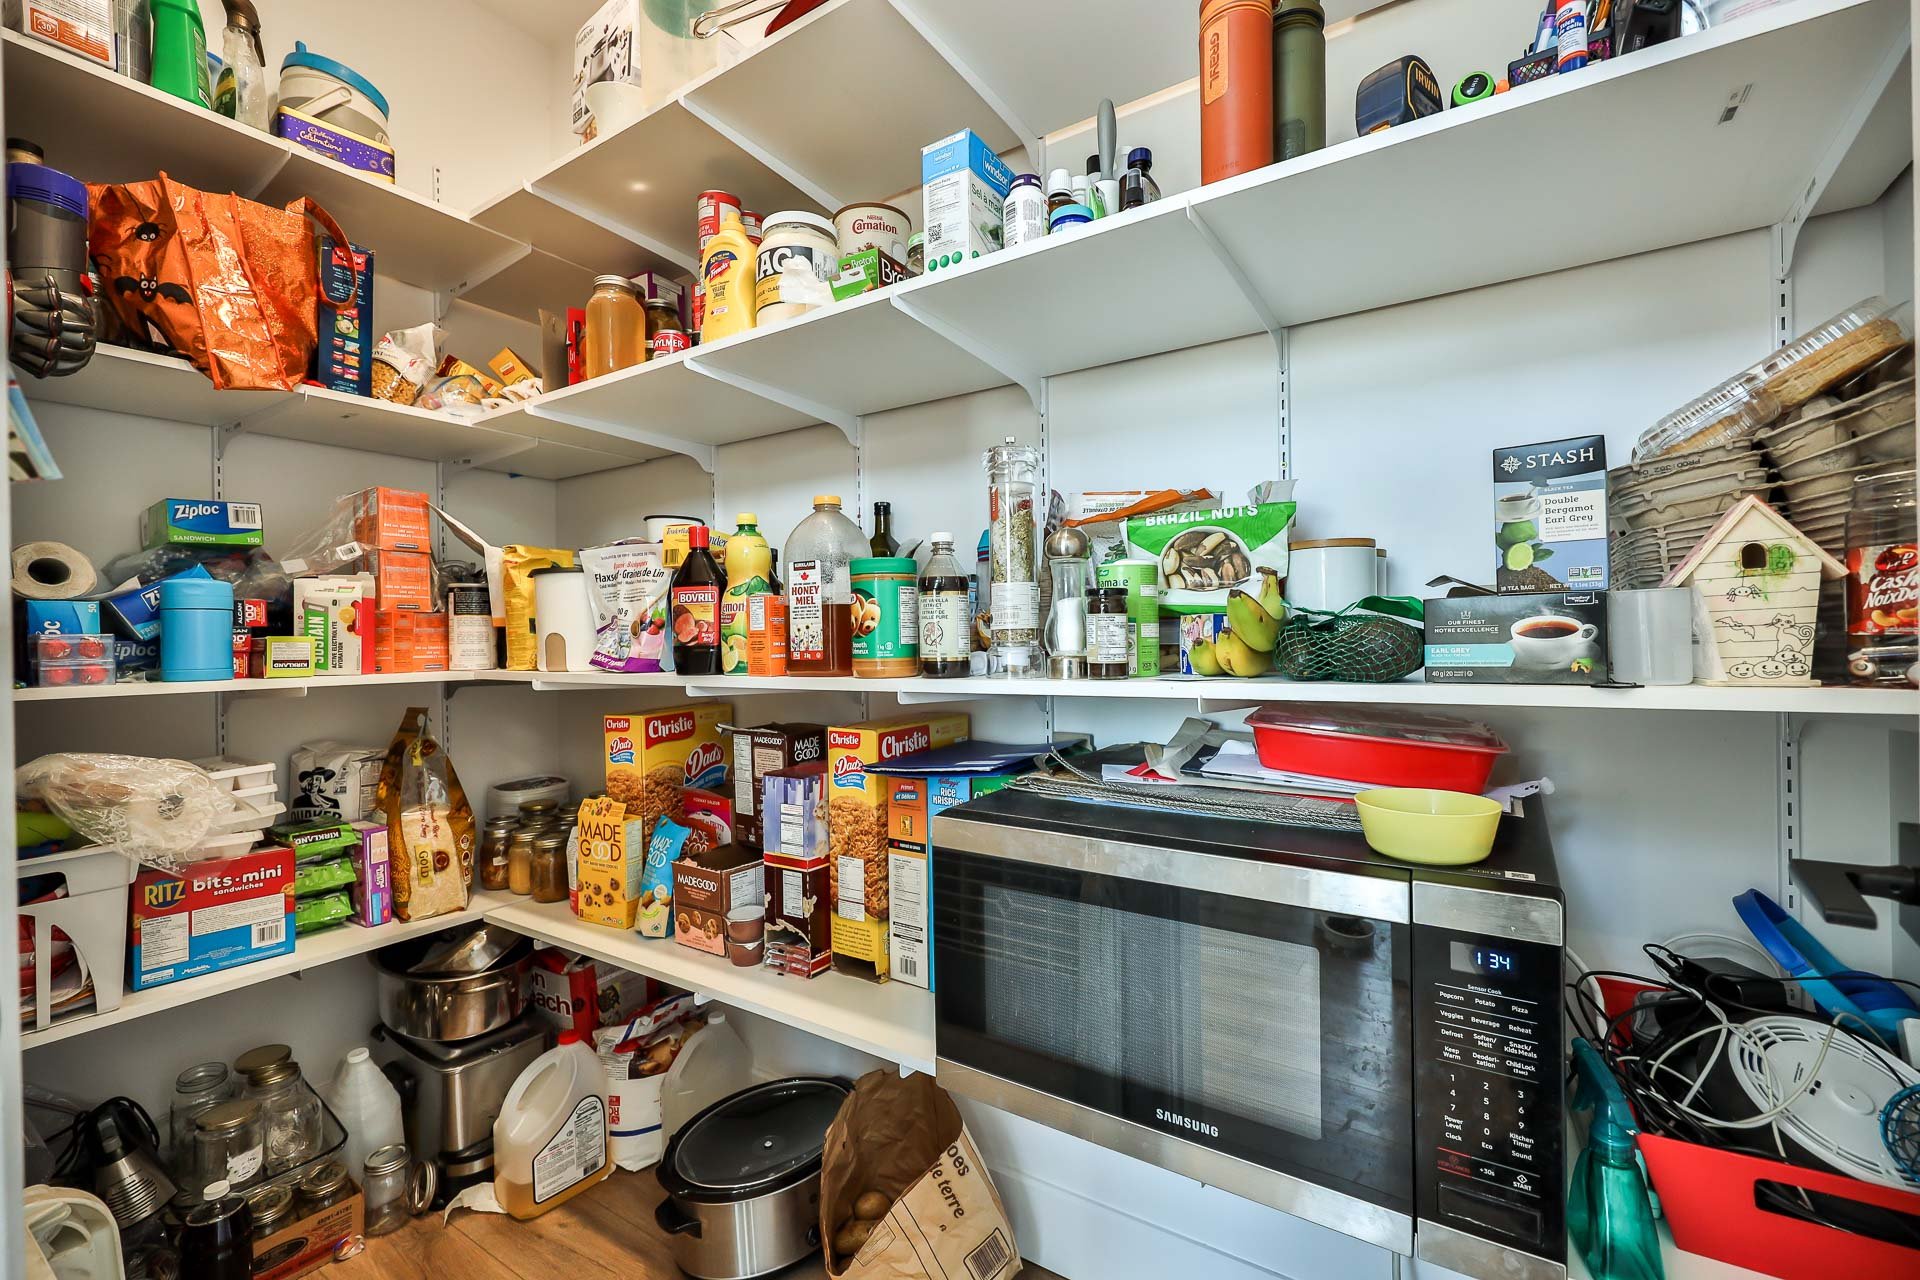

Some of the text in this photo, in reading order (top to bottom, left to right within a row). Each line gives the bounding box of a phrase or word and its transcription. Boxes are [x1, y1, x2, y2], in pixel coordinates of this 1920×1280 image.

[1209, 32, 1220, 90] GRAYL
[1415, 68, 1440, 100] IRWIN
[984, 160, 1008, 186] windsor
[852, 219, 898, 234] Carnation
[852, 256, 876, 268] Breton
[1526, 448, 1594, 468] STASH
[1544, 496, 1579, 506] Double
[174, 504, 220, 520] Ziploc
[1545, 504, 1594, 516] Bergamot
[1145, 505, 1258, 527] BRAZIL NUTS
[1545, 514, 1594, 524] Earl Grey
[652, 568, 664, 578] Lin
[792, 586, 820, 596] HONEY
[680, 592, 714, 603] BOVRIL
[796, 596, 816, 605] MIEL
[88, 604, 96, 613] 50
[606, 720, 629, 729] Christie
[648, 717, 693, 738] Christie
[794, 736, 820, 751] MADE
[830, 733, 859, 745] Christie
[881, 729, 928, 758] Christie
[612, 739, 631, 752] Dad's
[794, 747, 820, 761] GOOD
[688, 746, 721, 777] Dad's
[580, 820, 621, 843] MADE
[294, 831, 339, 845] KIRKLAND
[651, 835, 673, 849] MADE
[580, 839, 621, 862] GOOD
[418, 850, 430, 878] GOLD
[193, 864, 282, 892] bits mini
[677, 873, 717, 892] MADEGOOD
[144, 880, 186, 906] RITZ
[213, 882, 264, 896] sandwiches
[1467, 984, 1502, 996] Sensor Cook
[1440, 991, 1464, 1001] Popcorn
[1475, 998, 1496, 1008] Potato
[1440, 1010, 1464, 1020] Veggies
[1512, 1005, 1528, 1014] Pizza
[1471, 1016, 1500, 1028] Beverage
[1441, 1028, 1464, 1038] Defrost
[1509, 1024, 1532, 1035] Reheat
[1473, 1034, 1497, 1044] Soften/
[1478, 1040, 1493, 1049] Melt
[1444, 1046, 1460, 1054] Keep
[1509, 1041, 1531, 1051] Snack/
[1443, 1051, 1461, 1060] Warm
[1472, 1052, 1500, 1062] Deodori-
[1504, 1046, 1537, 1059] Kids Meals
[1476, 1060, 1496, 1068] zation
[1506, 1060, 1536, 1072] Child Lock
[1483, 1082, 1489, 1090] 2
[1518, 1090, 1524, 1098] 3
[1484, 1097, 1489, 1105] 5
[1518, 1106, 1524, 1114] 6
[1444, 1115, 1463, 1125] Power
[1484, 1112, 1490, 1120] 8
[1156, 1108, 1219, 1138] SAMSUNG
[1445, 1122, 1462, 1130] Level
[1445, 1132, 1462, 1142] Clock
[1510, 1132, 1534, 1144] Kitchen
[1482, 1142, 1493, 1150] Eco
[1512, 1139, 1532, 1149] Timer
[1511, 1150, 1532, 1161] Sound
[1480, 1167, 1495, 1177] +30s
[1513, 1181, 1532, 1192] START
[938, 1179, 965, 1219] terre
